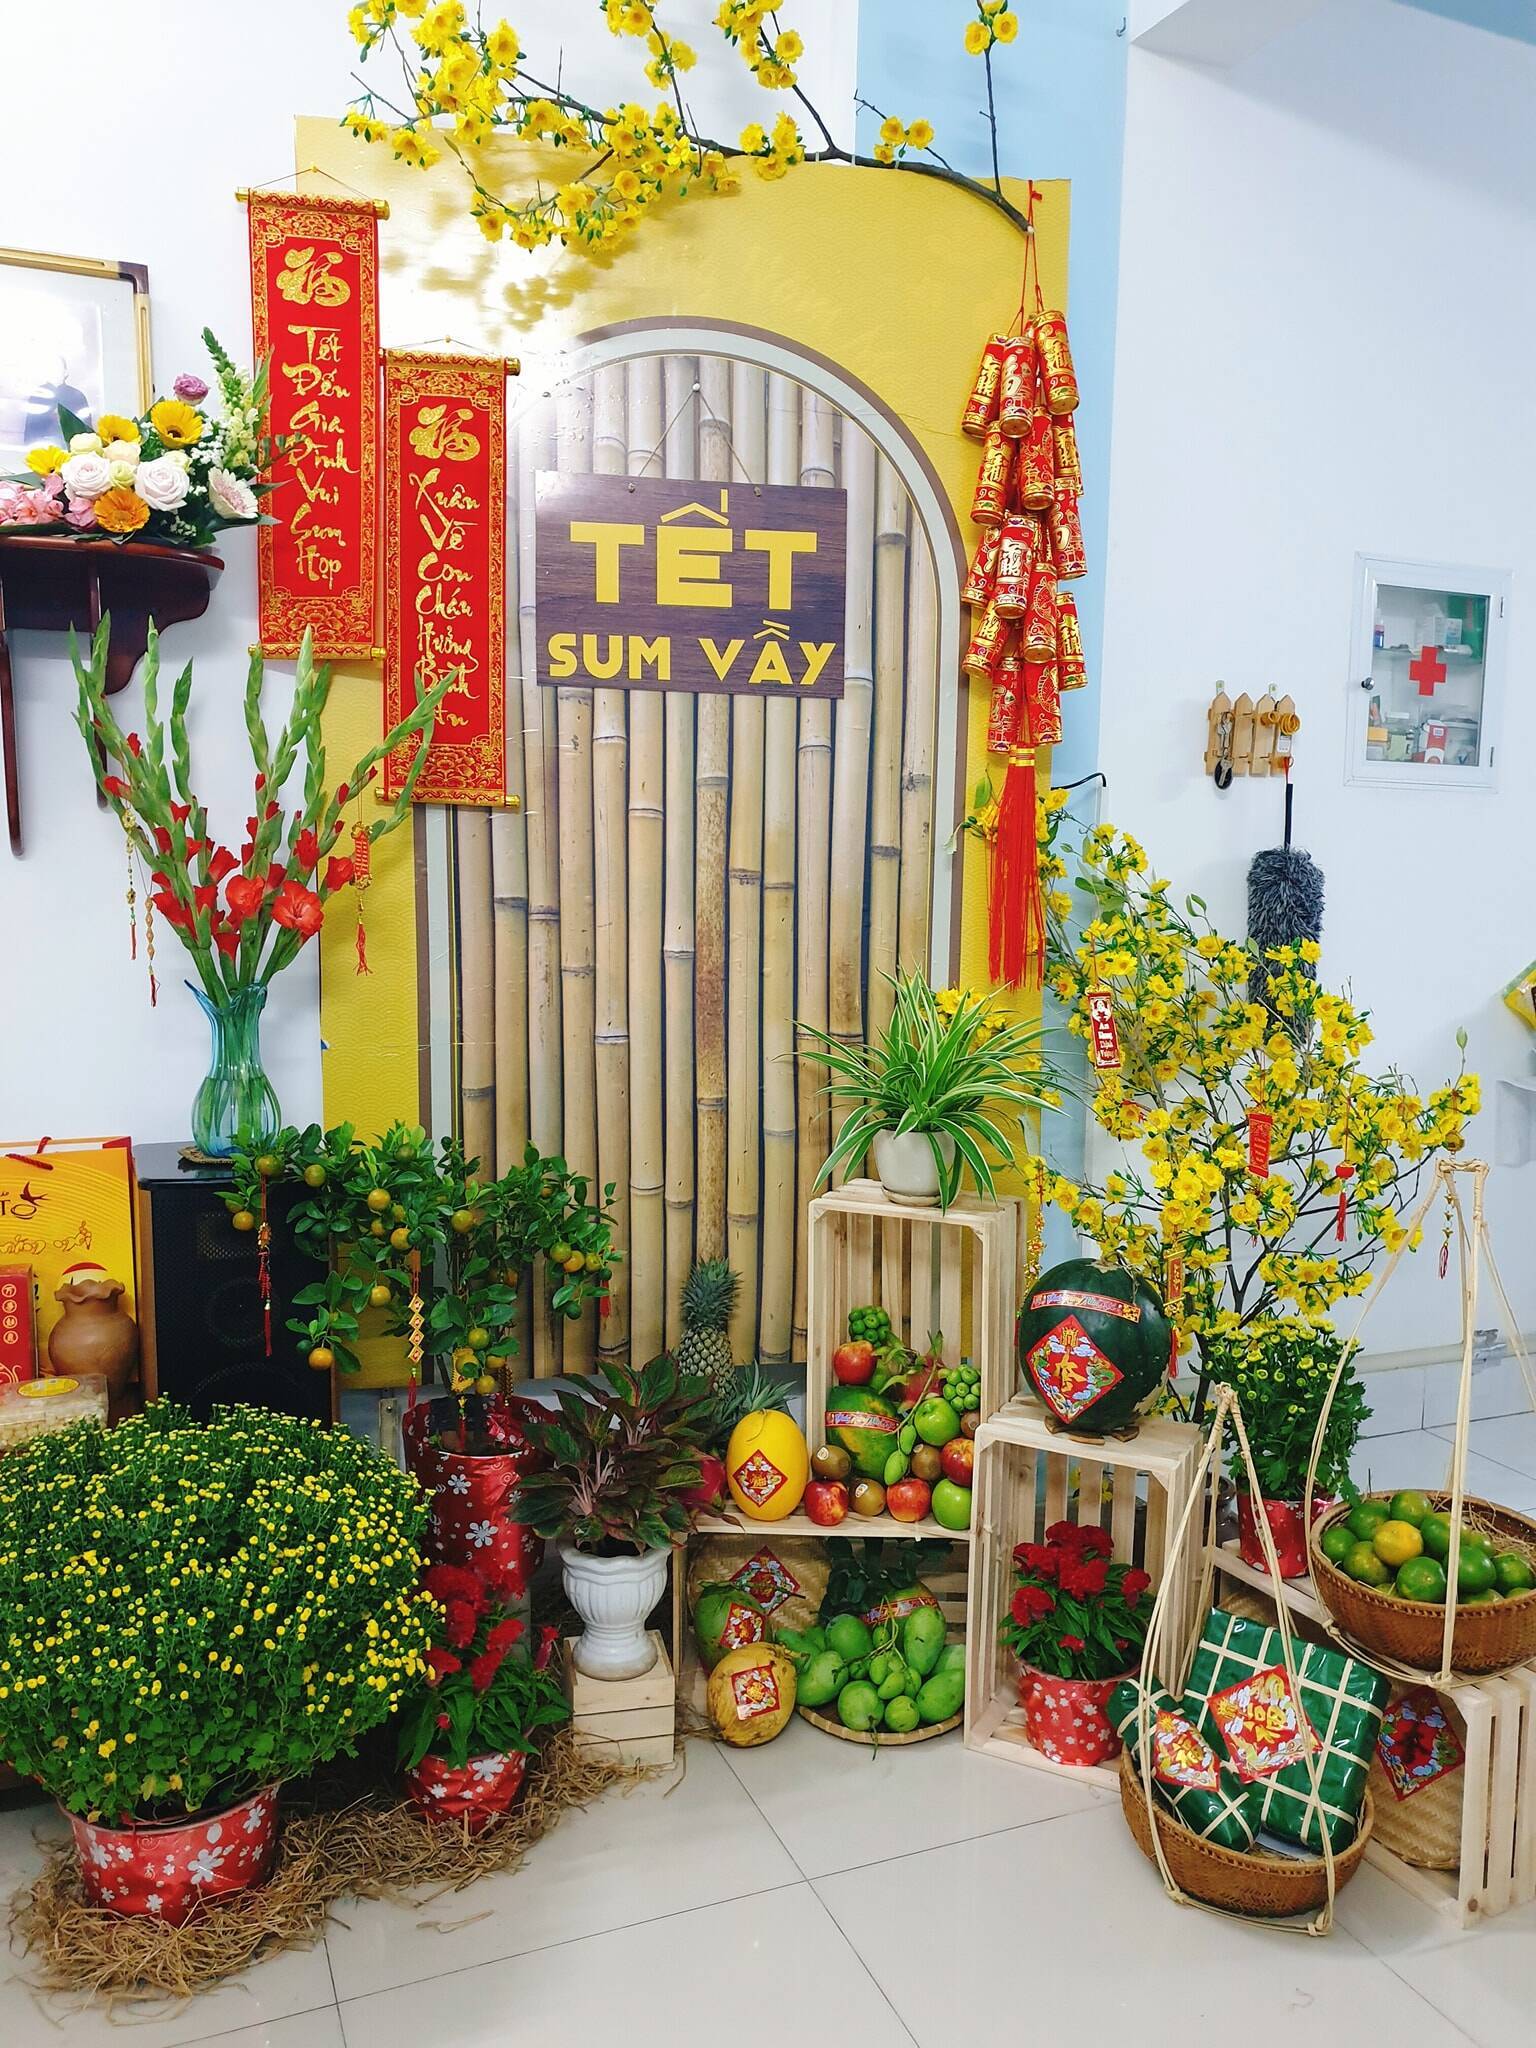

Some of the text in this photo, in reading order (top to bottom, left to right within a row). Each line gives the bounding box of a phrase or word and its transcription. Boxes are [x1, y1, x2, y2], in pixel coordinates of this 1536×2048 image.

[282, 324, 360, 590] Tết Đến Gia Đình Vui Sum Họp
[408, 467, 480, 528] Xuân
[419, 513, 479, 551] Về
[569, 488, 818, 610] TẾT
[417, 552, 473, 582] Con
[415, 583, 473, 620] Cháu
[547, 618, 837, 686] SUM VẦY
